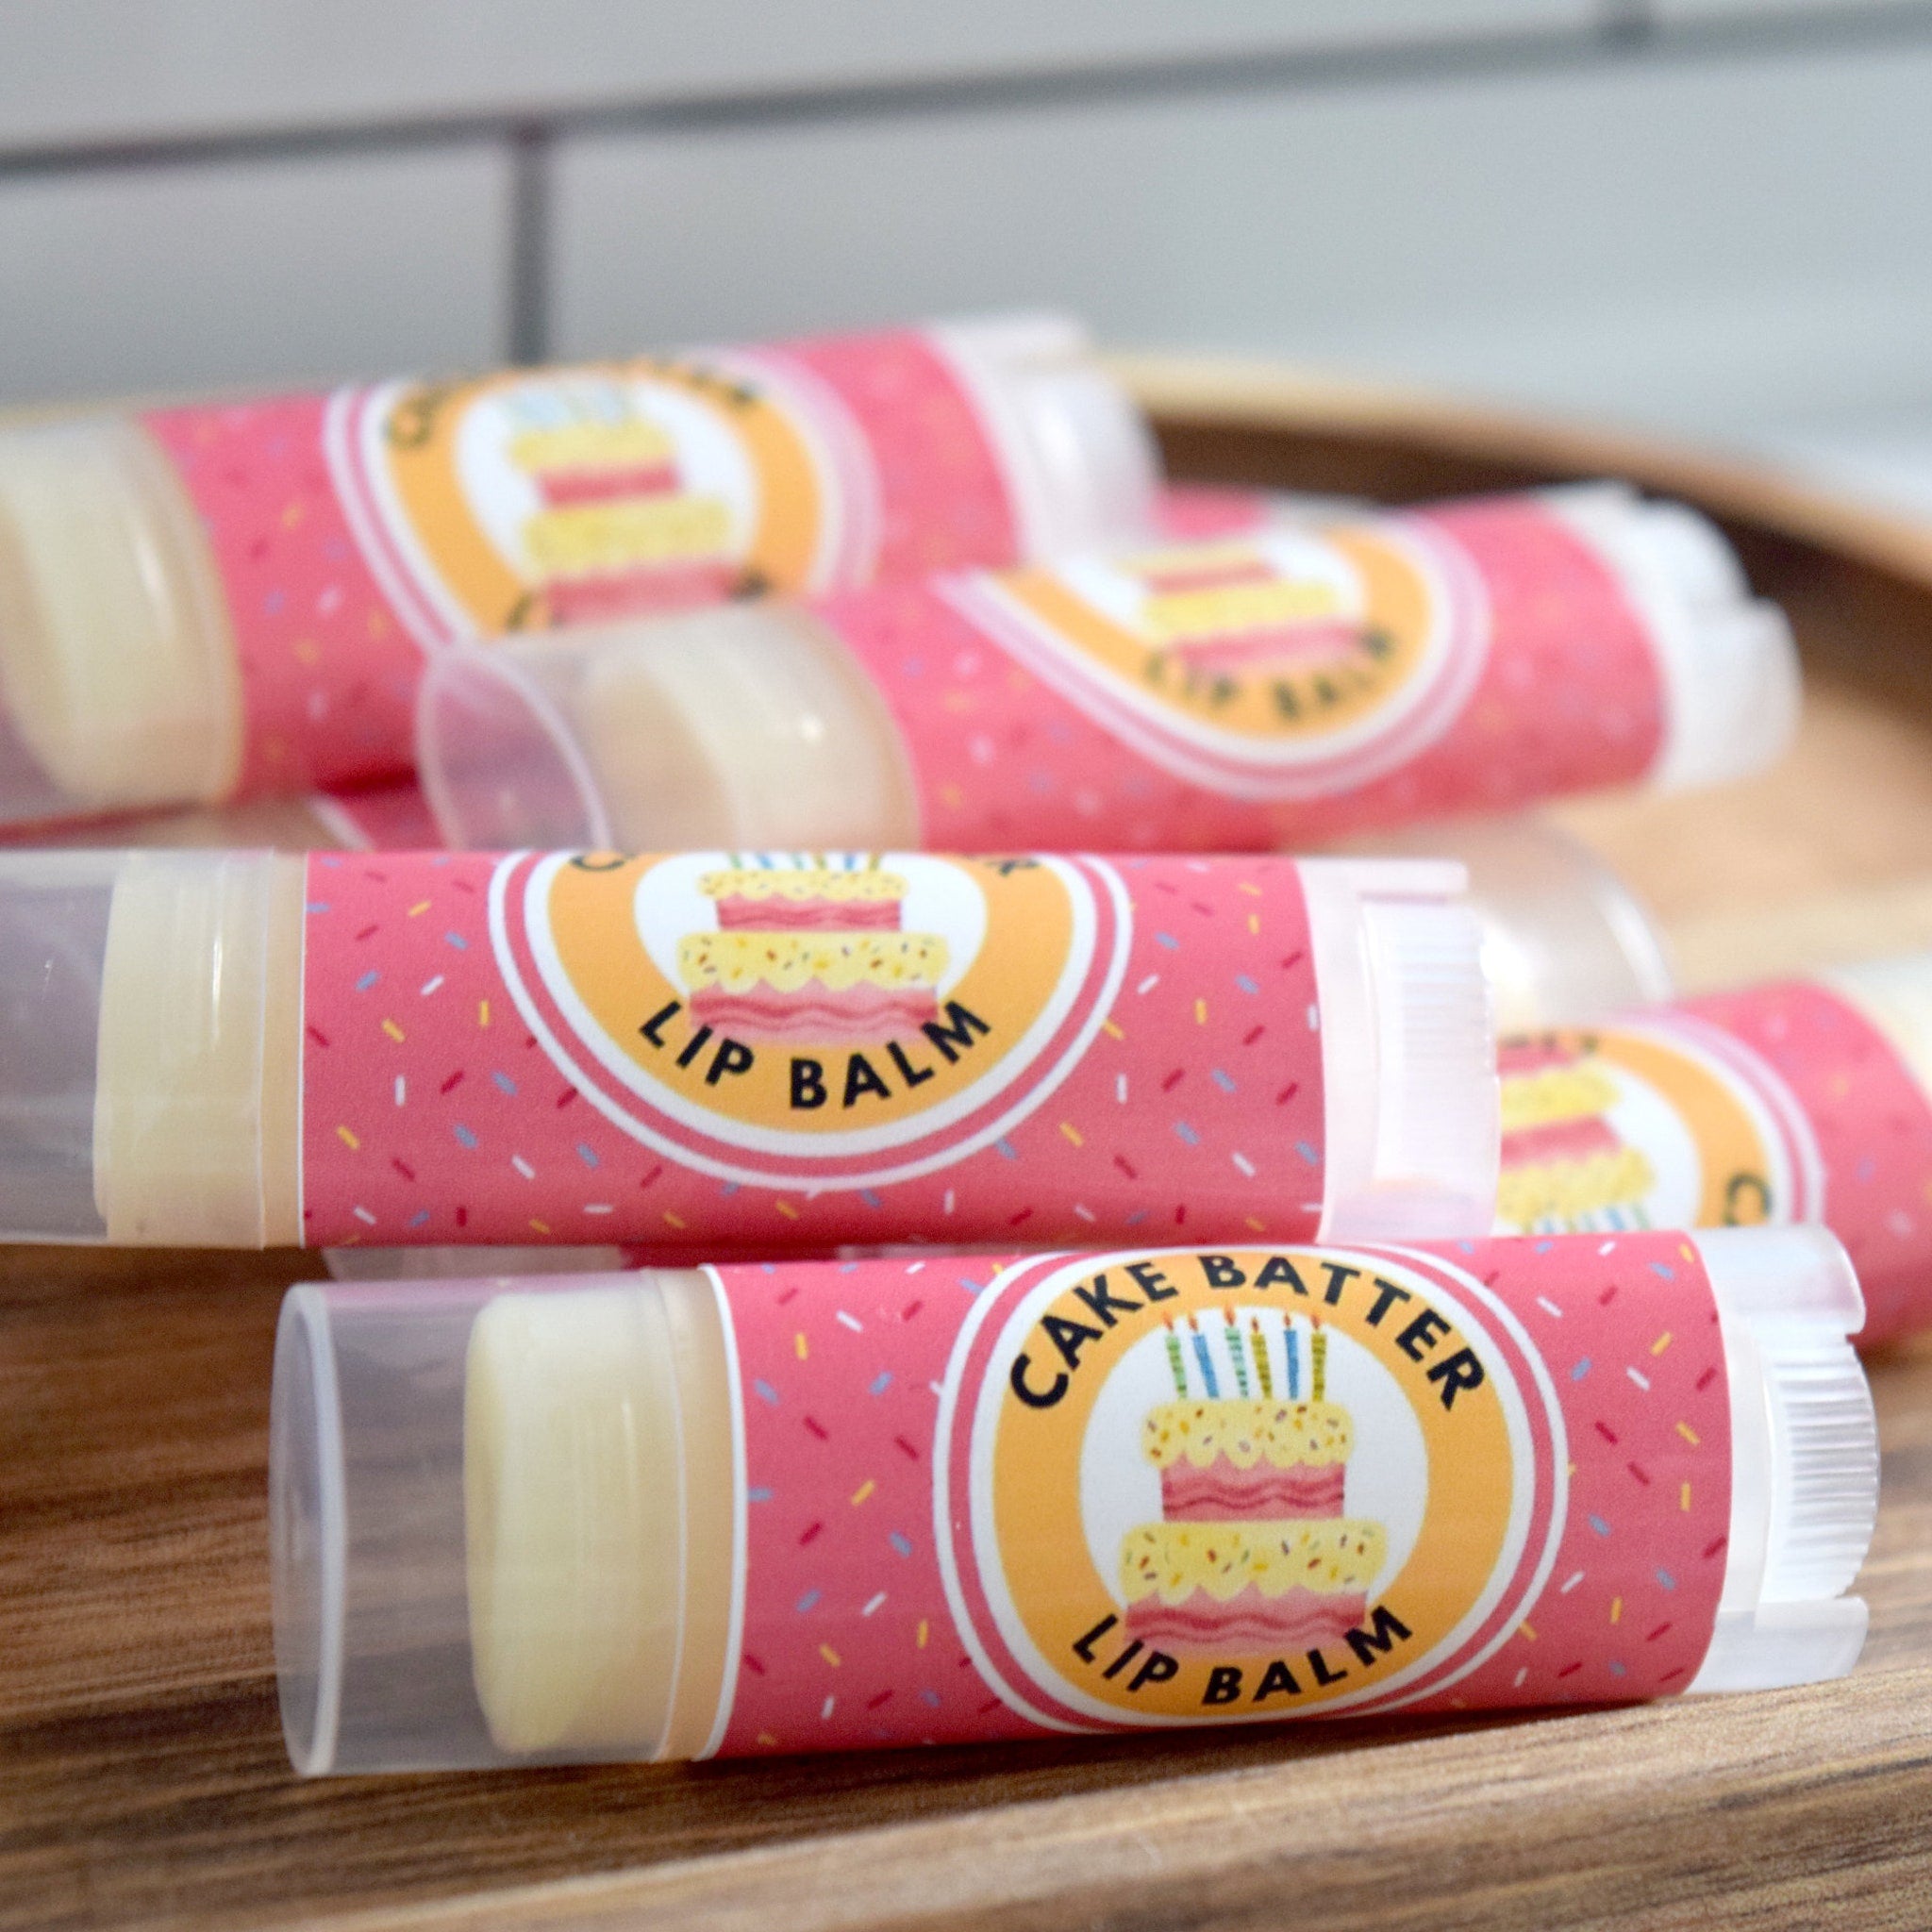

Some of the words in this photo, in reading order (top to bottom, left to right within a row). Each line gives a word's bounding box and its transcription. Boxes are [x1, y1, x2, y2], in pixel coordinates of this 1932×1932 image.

[639, 1000, 756, 1087] LIP
[790, 1000, 991, 1110] BALM
[1009, 1259, 1178, 1409] CAKE
[1196, 1255, 1486, 1411] BATTER
[1072, 1612, 1180, 1694] LIP
[1201, 1605, 1414, 1707] BALM
